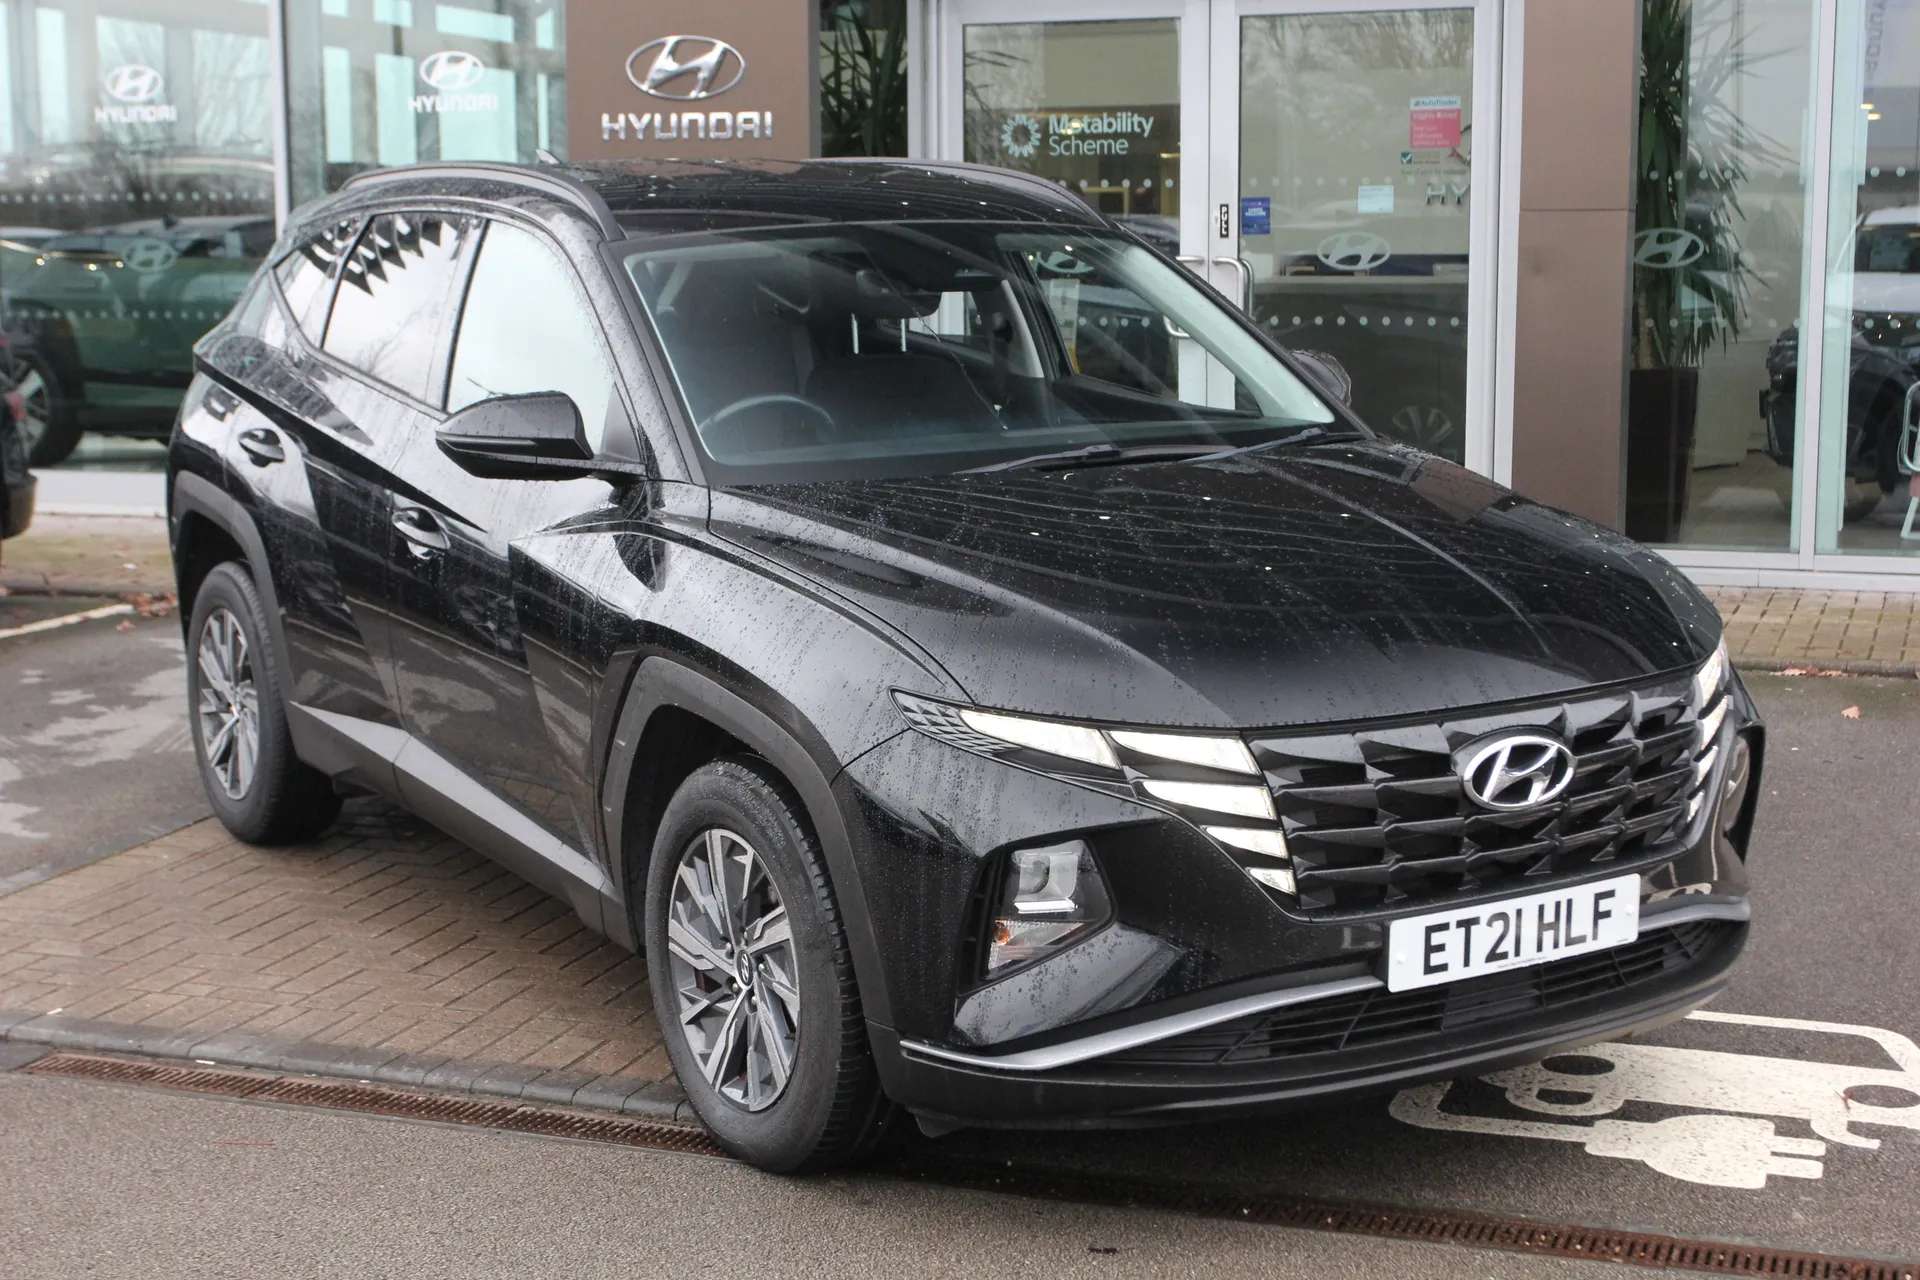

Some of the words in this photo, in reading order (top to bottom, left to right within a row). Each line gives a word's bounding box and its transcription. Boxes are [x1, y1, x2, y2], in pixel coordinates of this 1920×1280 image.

[94, 104, 177, 123] HYUNDAI
[407, 94, 498, 113] HYUNDAI
[600, 111, 772, 140] HYUNDAI
[1048, 112, 1154, 138] Motability
[1048, 135, 1129, 156] Scheme
[1423, 908, 1522, 975] ET21
[1536, 889, 1616, 953] HLF
